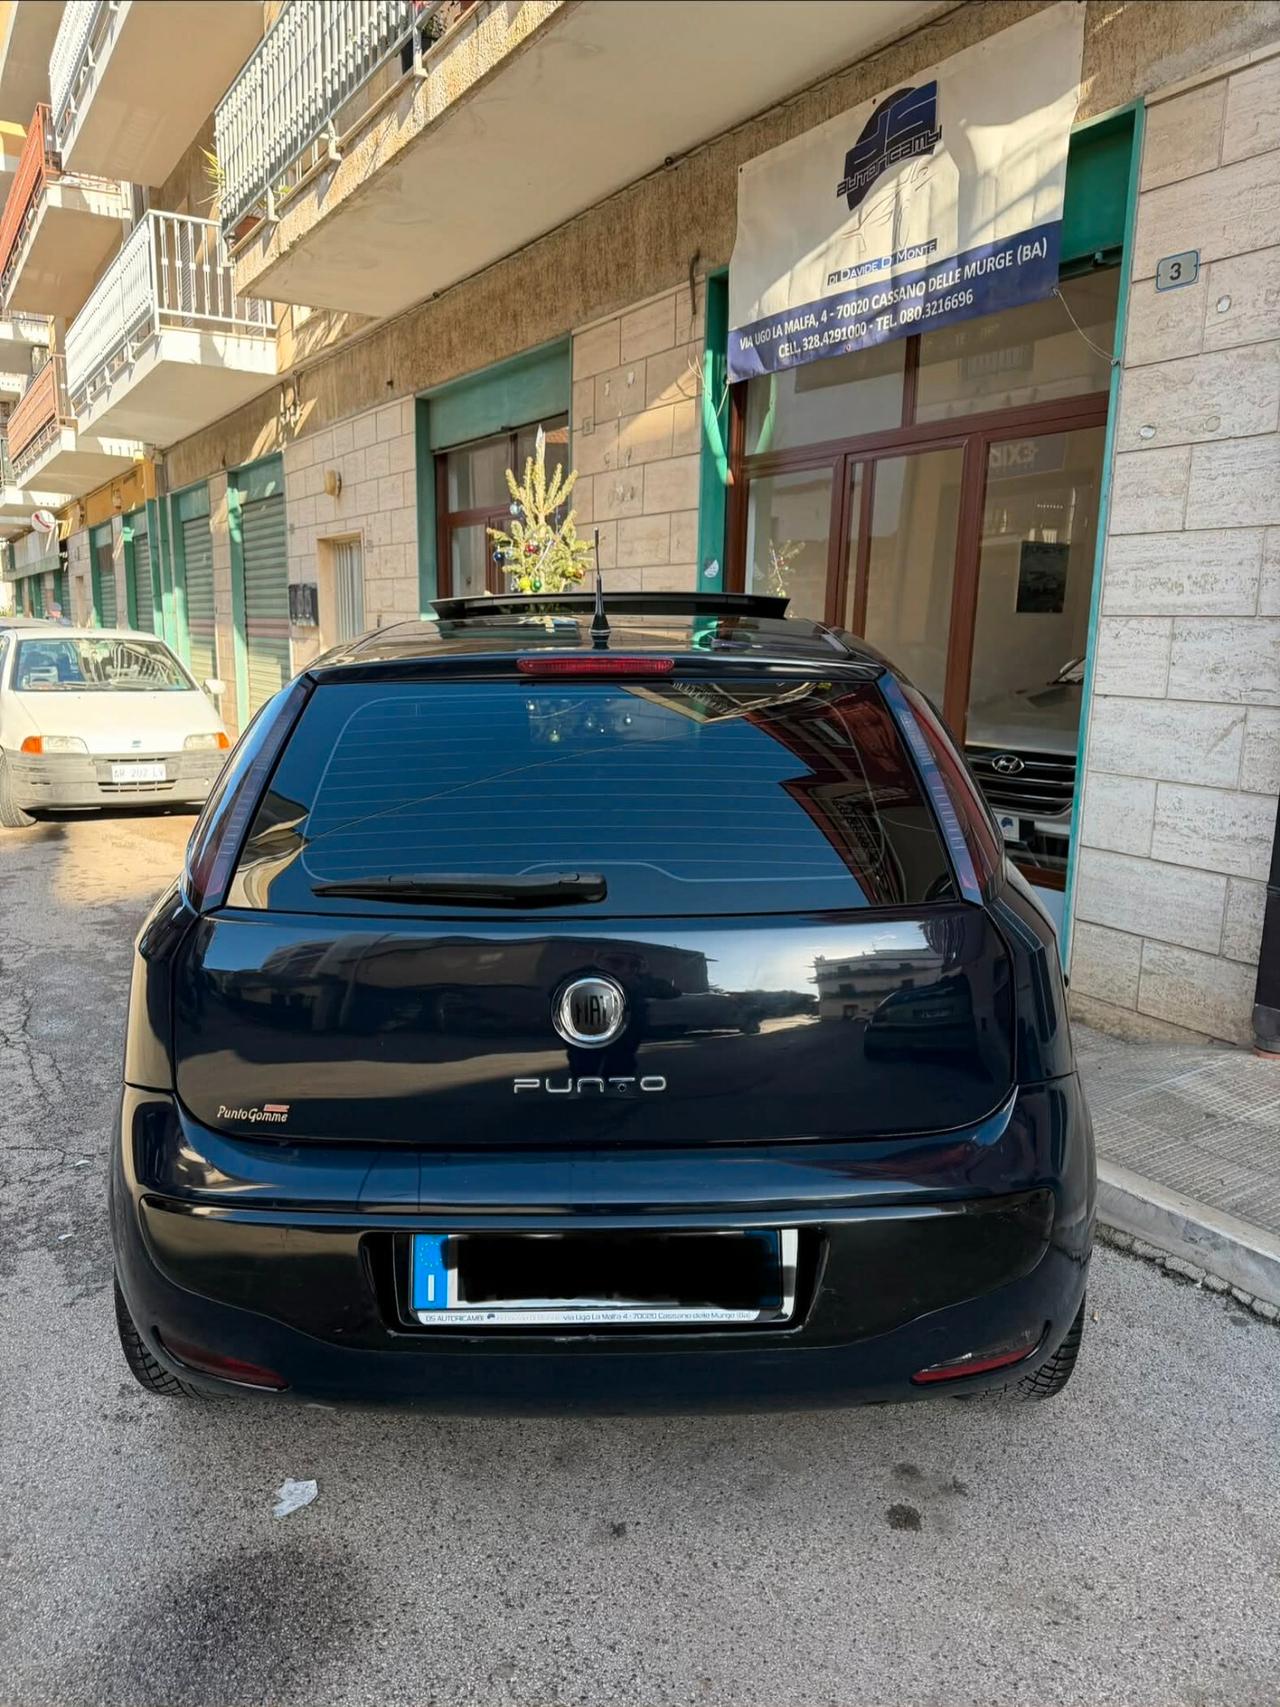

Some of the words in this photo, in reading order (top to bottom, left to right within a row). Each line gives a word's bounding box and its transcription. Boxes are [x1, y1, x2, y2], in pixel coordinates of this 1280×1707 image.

[739, 336, 754, 350] VIA
[755, 329, 771, 346] UGO
[772, 324, 784, 339] LA
[784, 312, 819, 335] MALFA,
[821, 309, 828, 323] 4
[837, 297, 869, 319] 70020
[871, 281, 926, 311] CASSANO
[928, 267, 961, 293] DELLE
[963, 250, 1013, 280] MURGE
[1017, 237, 1047, 265] (BA)
[1169, 262, 1182, 281] 3
[778, 342, 801, 358] CELL.
[802, 321, 867, 351] 328.4291000
[876, 310, 897, 332] TEL.
[899, 288, 974, 325] 080.3216696
[513, 1076, 667, 1094] PUNTO
